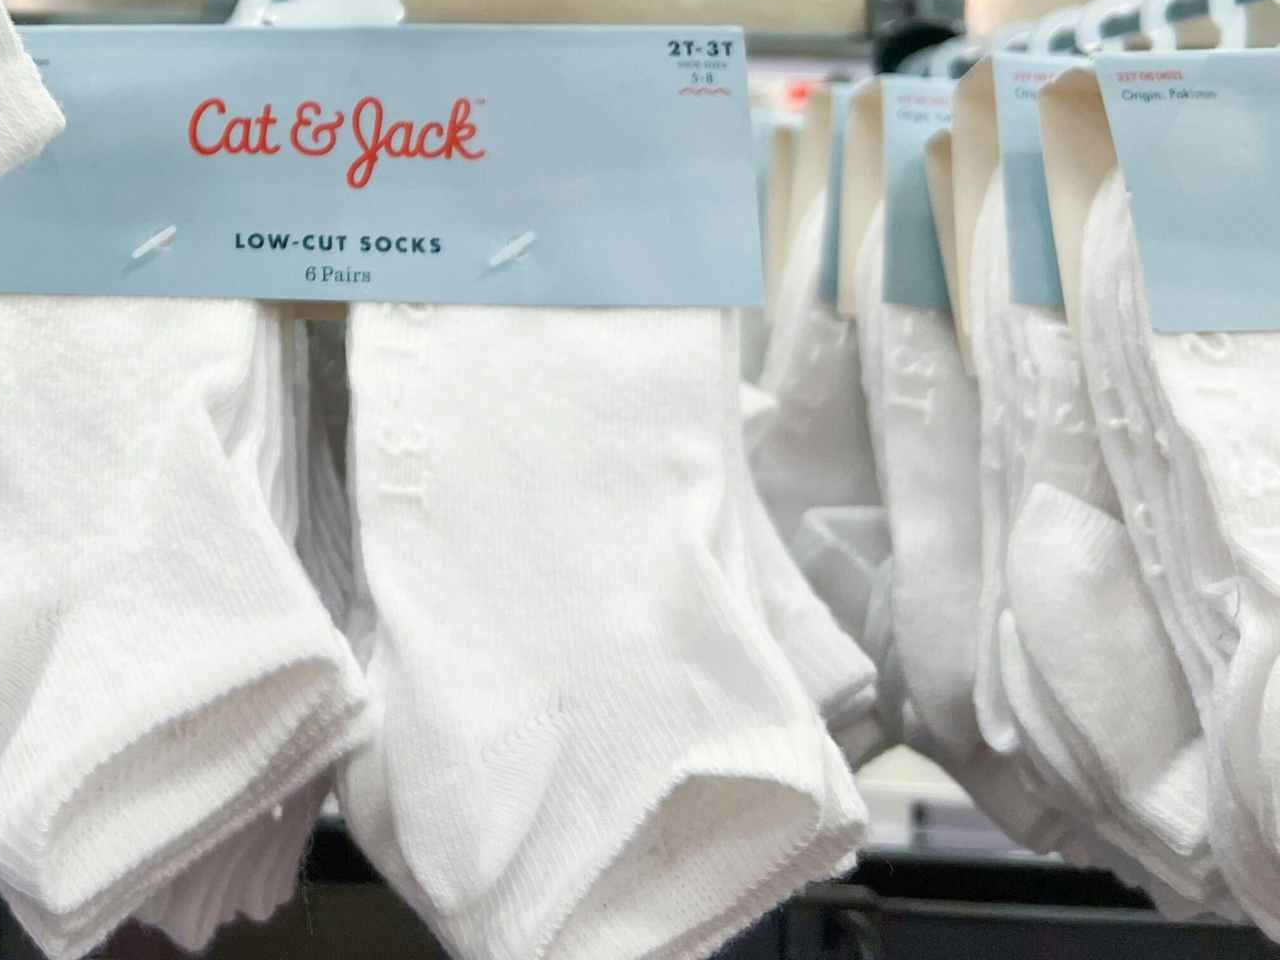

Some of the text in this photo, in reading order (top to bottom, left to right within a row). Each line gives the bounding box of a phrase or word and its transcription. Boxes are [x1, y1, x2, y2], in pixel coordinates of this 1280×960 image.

[667, 39, 734, 57] 2T-3T
[187, 96, 487, 190] Cat & Jack
[234, 232, 443, 254] LOW-CUT SOCKS
[304, 266, 372, 284] 6 Pairs
